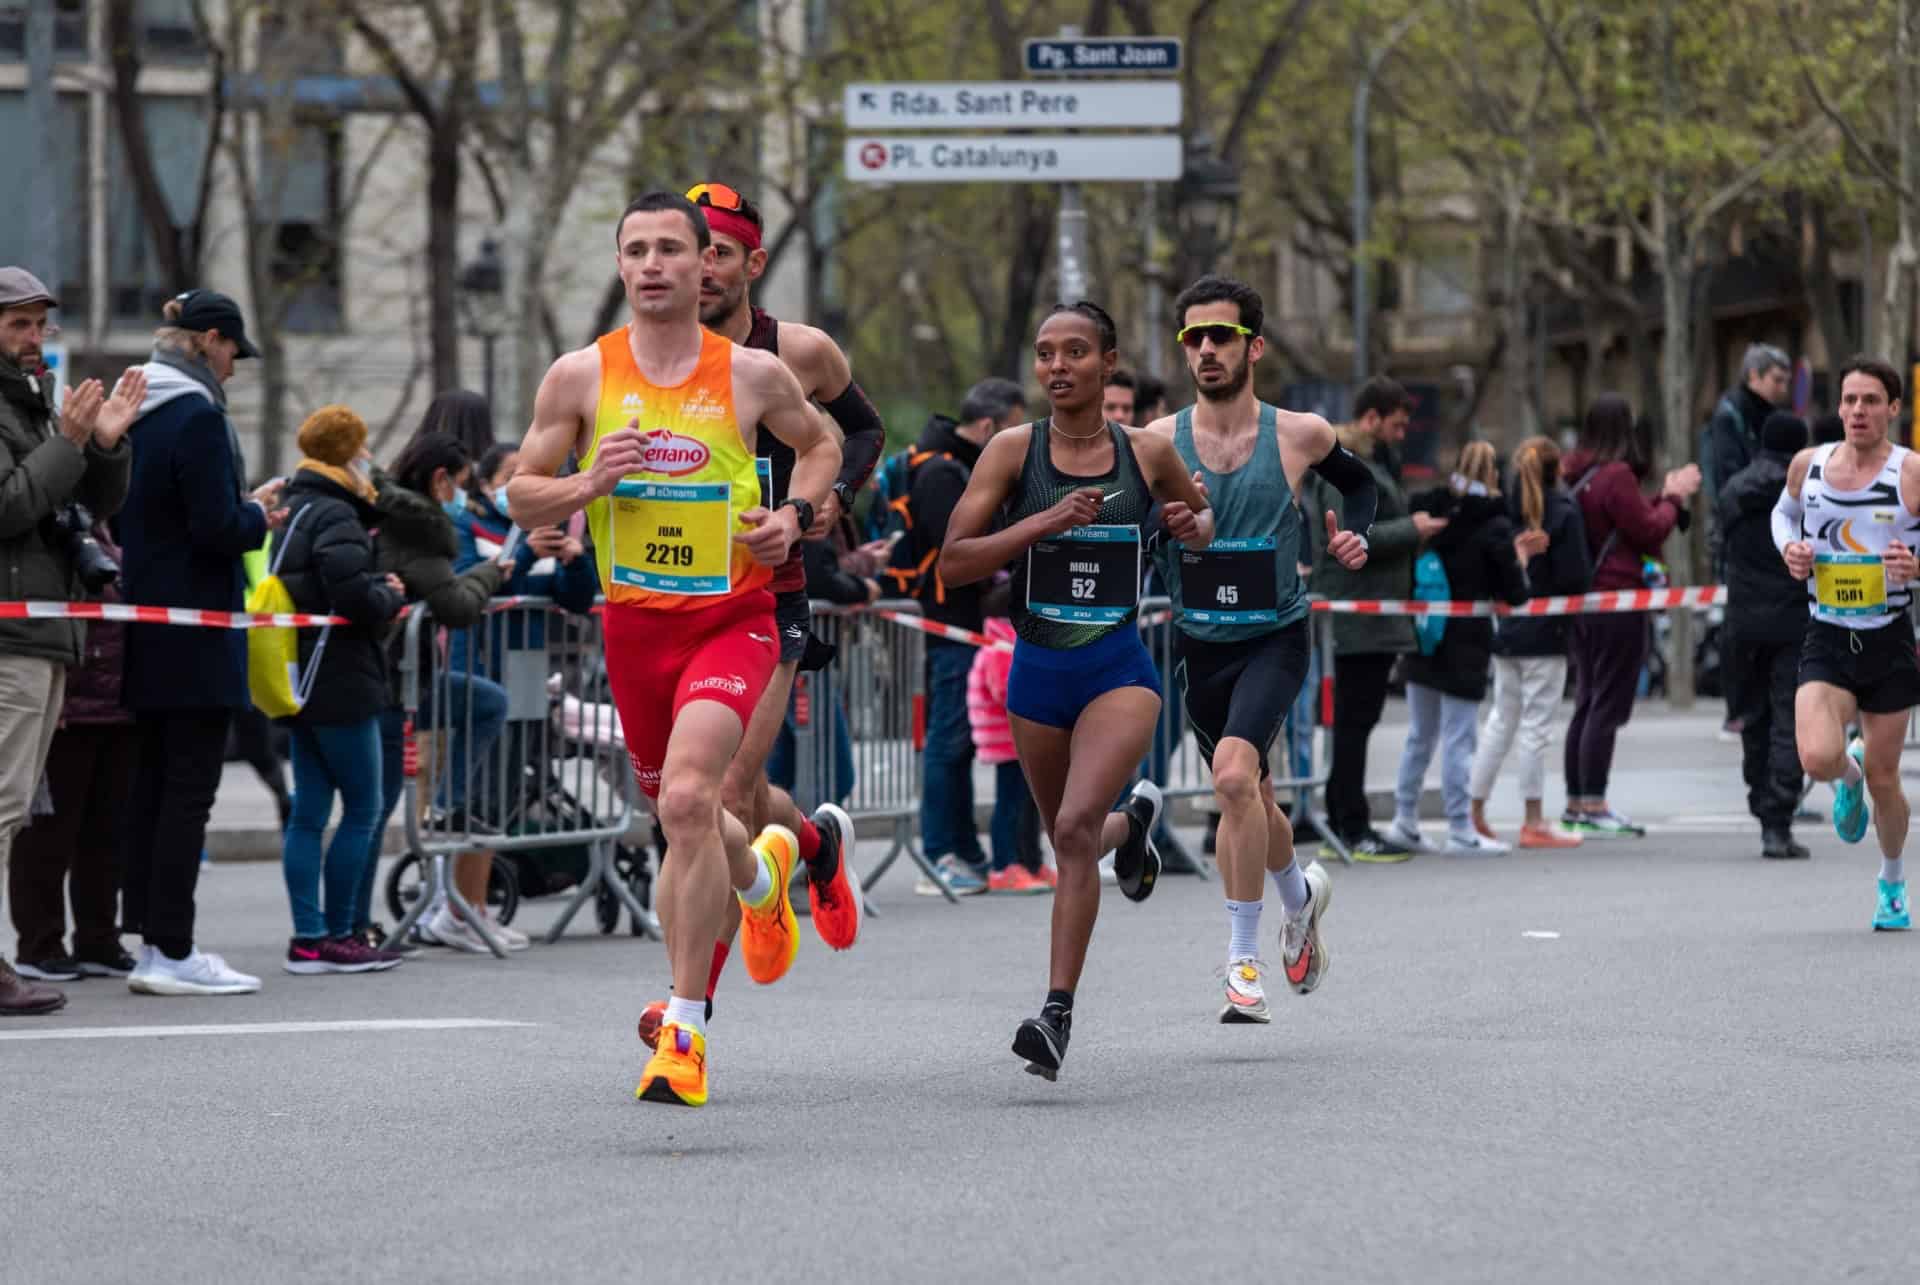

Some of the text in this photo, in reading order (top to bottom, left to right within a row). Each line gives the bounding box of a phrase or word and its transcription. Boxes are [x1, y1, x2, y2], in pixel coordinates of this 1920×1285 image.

[1037, 46, 1168, 68] Pg. Sant Joan
[890, 91, 1078, 114] Rda. Sant Pere
[931, 143, 1059, 172] Catalunya
[643, 446, 704, 463] errano
[657, 525, 683, 537] JUAN
[1072, 527, 1109, 538] eDreams
[644, 543, 693, 566] 2219
[1069, 561, 1100, 574] MOLLA
[1071, 578, 1096, 599] 52
[1216, 585, 1238, 604] 45
